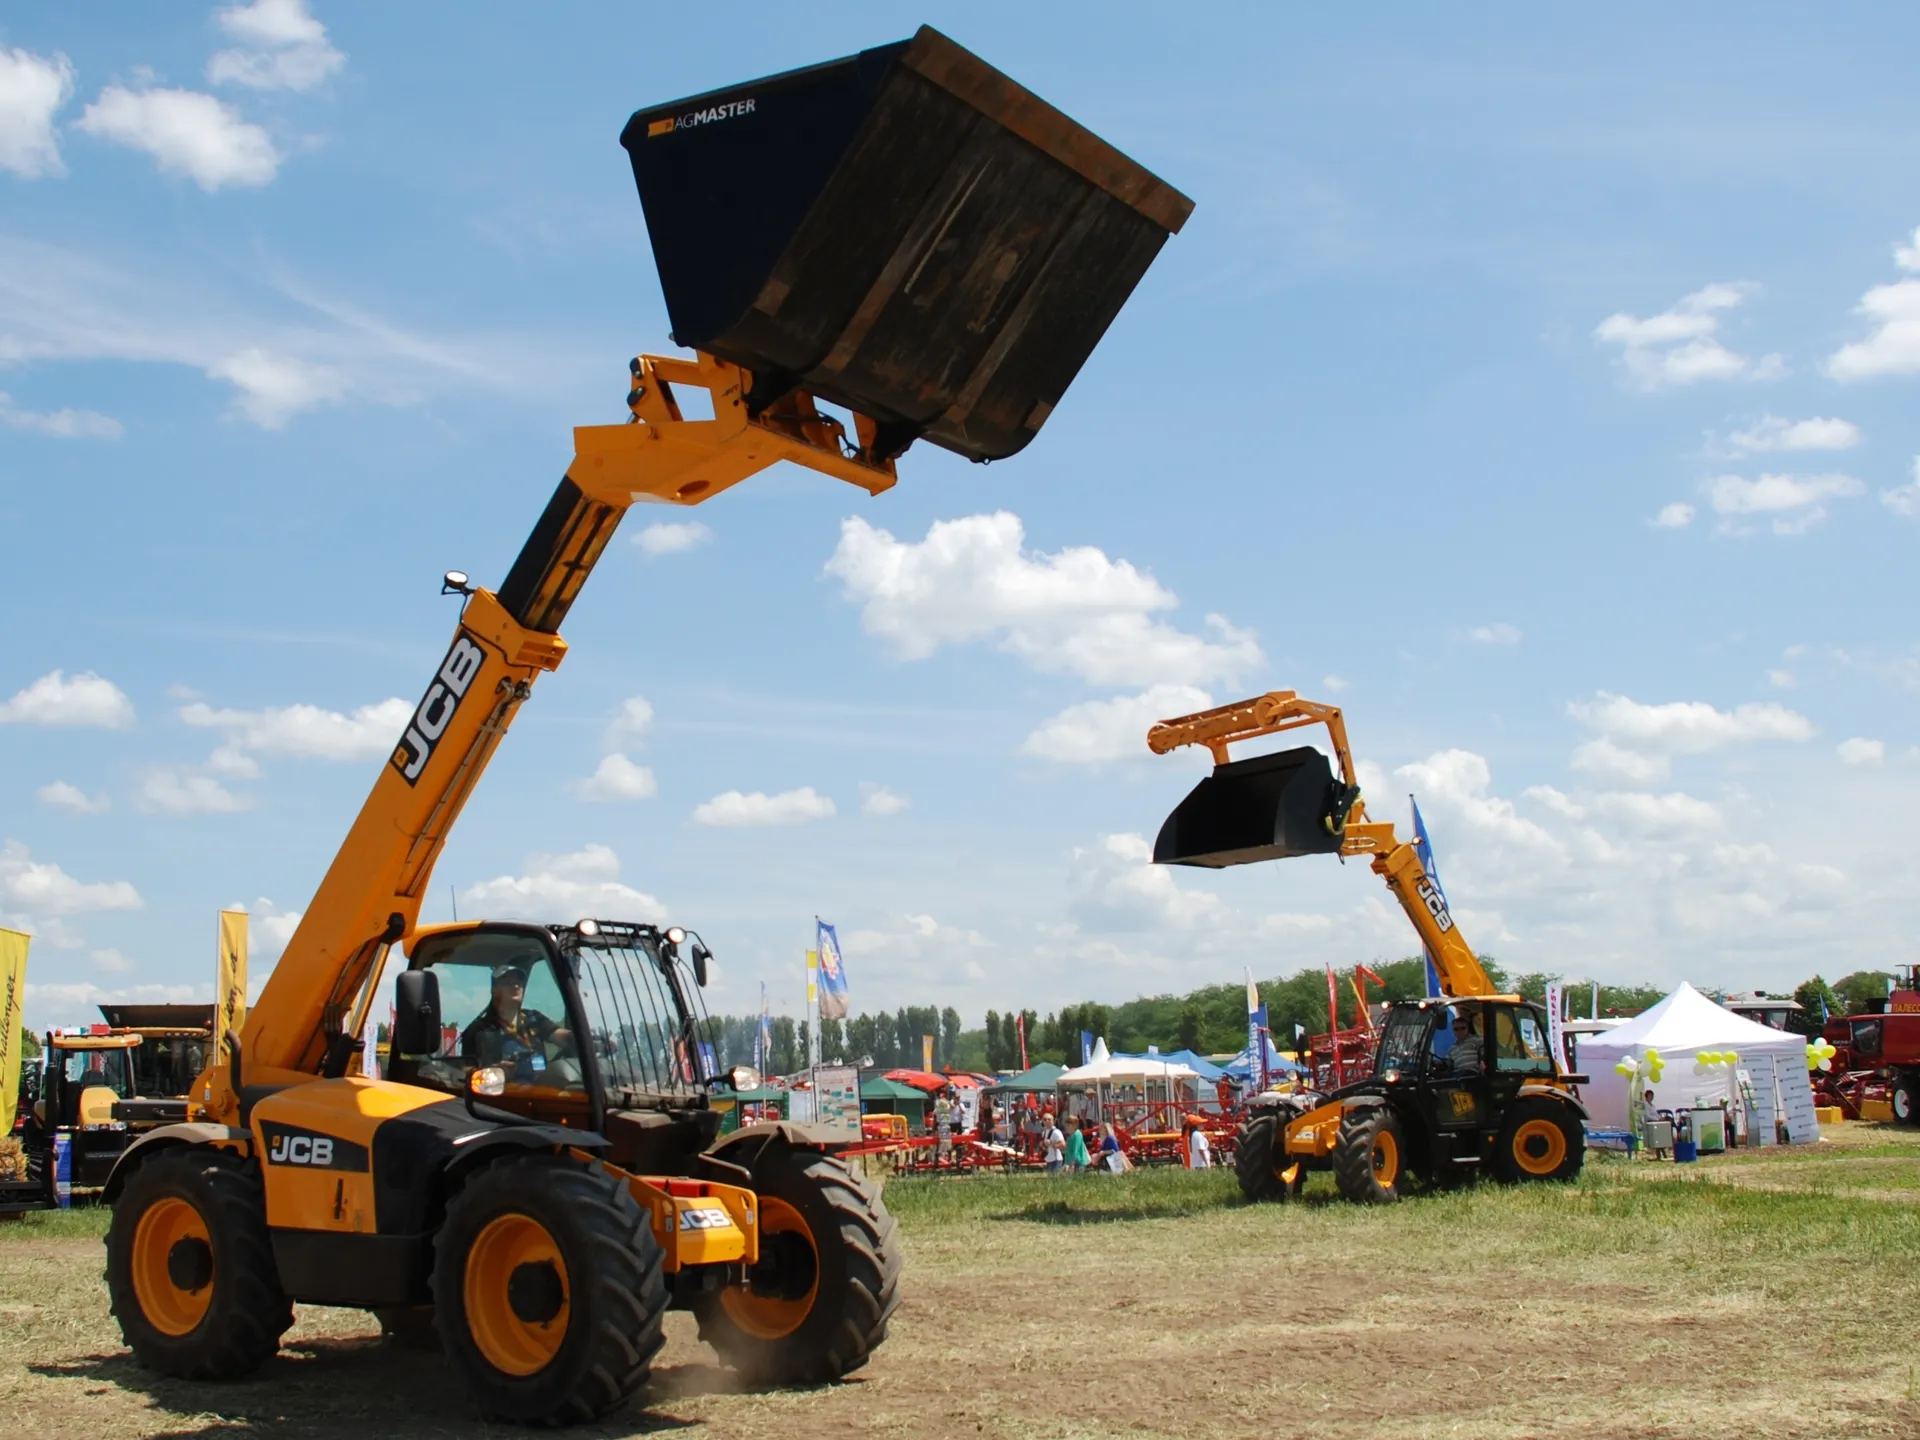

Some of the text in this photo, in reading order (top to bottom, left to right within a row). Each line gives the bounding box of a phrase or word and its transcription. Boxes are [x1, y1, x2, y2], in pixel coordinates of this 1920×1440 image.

[675, 99, 756, 130] AGMASTER
[404, 637, 482, 779] JCB
[1417, 884, 1452, 933] JCB
[271, 1135, 334, 1165] JCB
